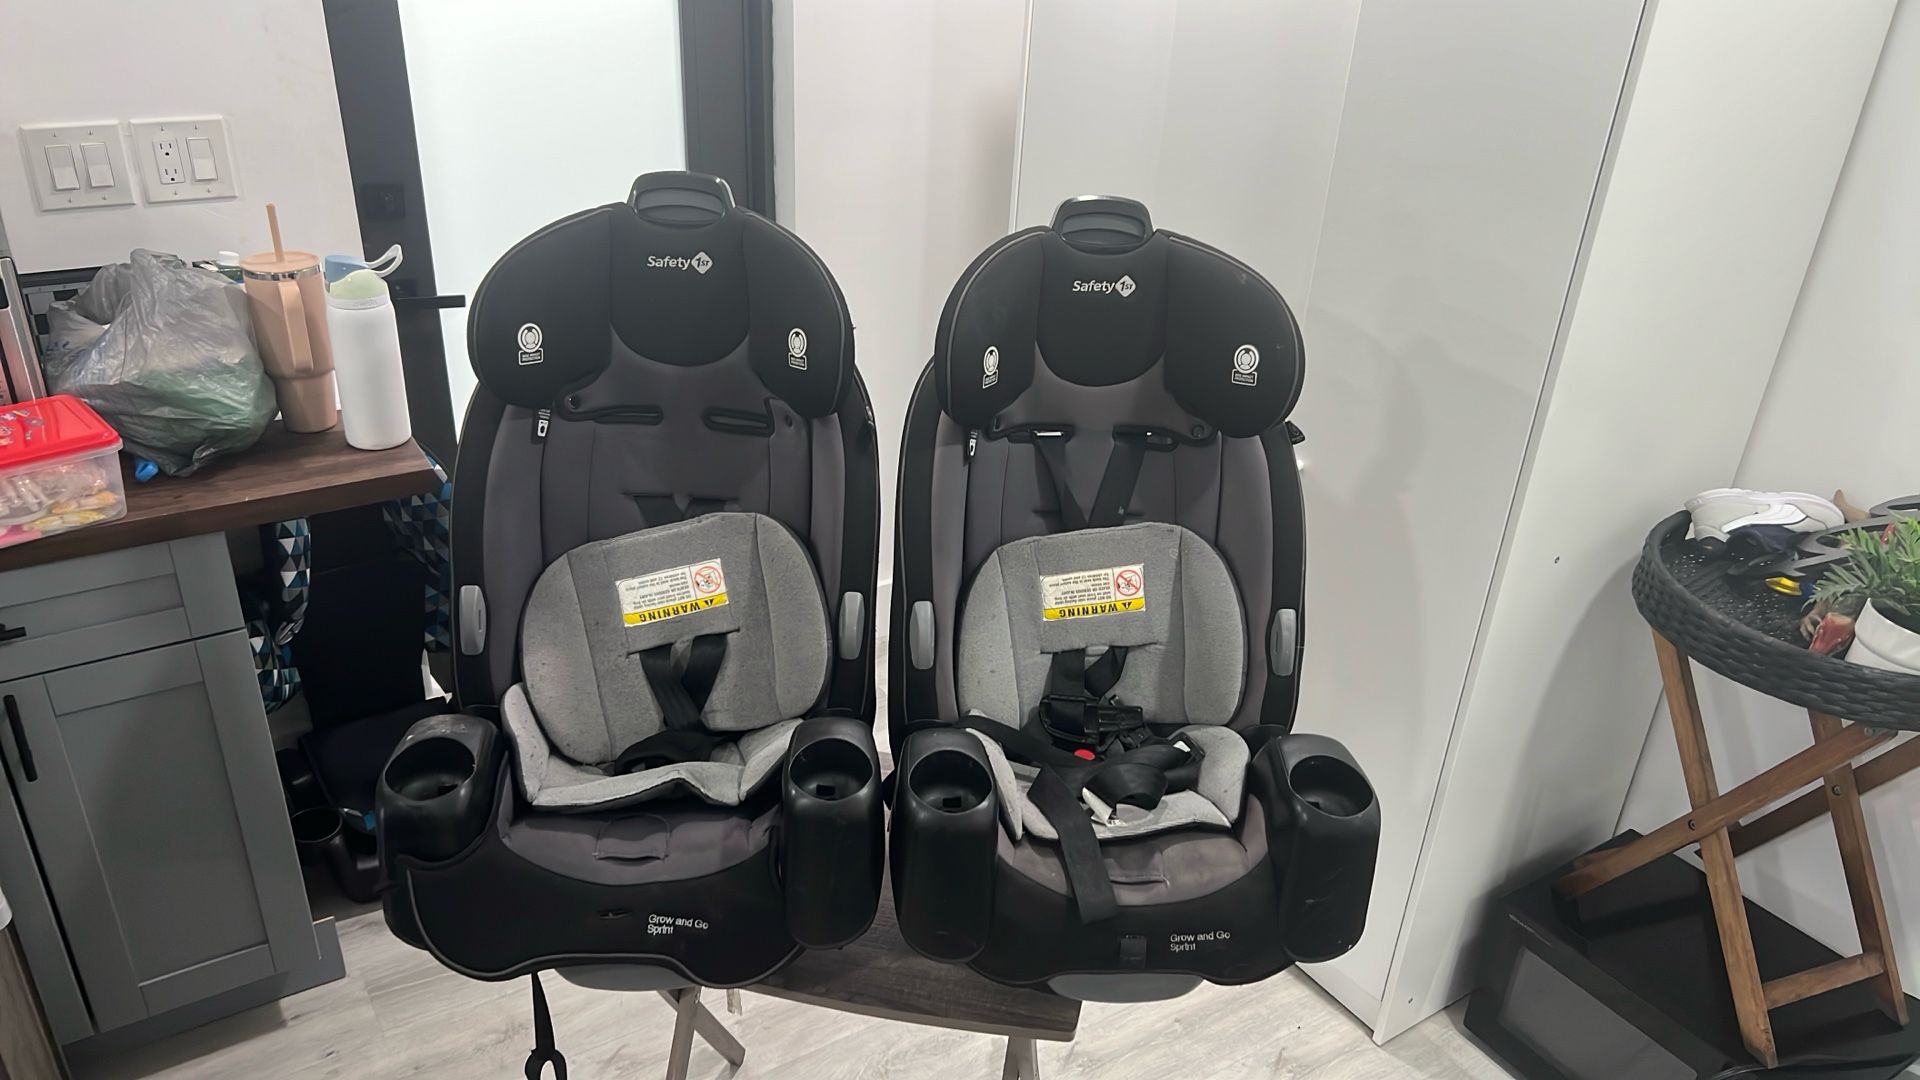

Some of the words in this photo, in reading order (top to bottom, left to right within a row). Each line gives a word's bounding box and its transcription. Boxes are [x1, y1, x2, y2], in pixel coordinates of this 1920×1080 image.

[647, 255, 691, 271] Safety
[1072, 280, 1116, 294] Safety
[639, 604, 701, 622] WARNING
[1059, 603, 1117, 618] WARNING
[649, 914, 675, 925] Grow
[675, 917, 694, 927] and
[694, 919, 709, 930] Go
[1170, 933, 1195, 942] Grow
[1196, 931, 1214, 941] and
[1216, 930, 1231, 939] Go
